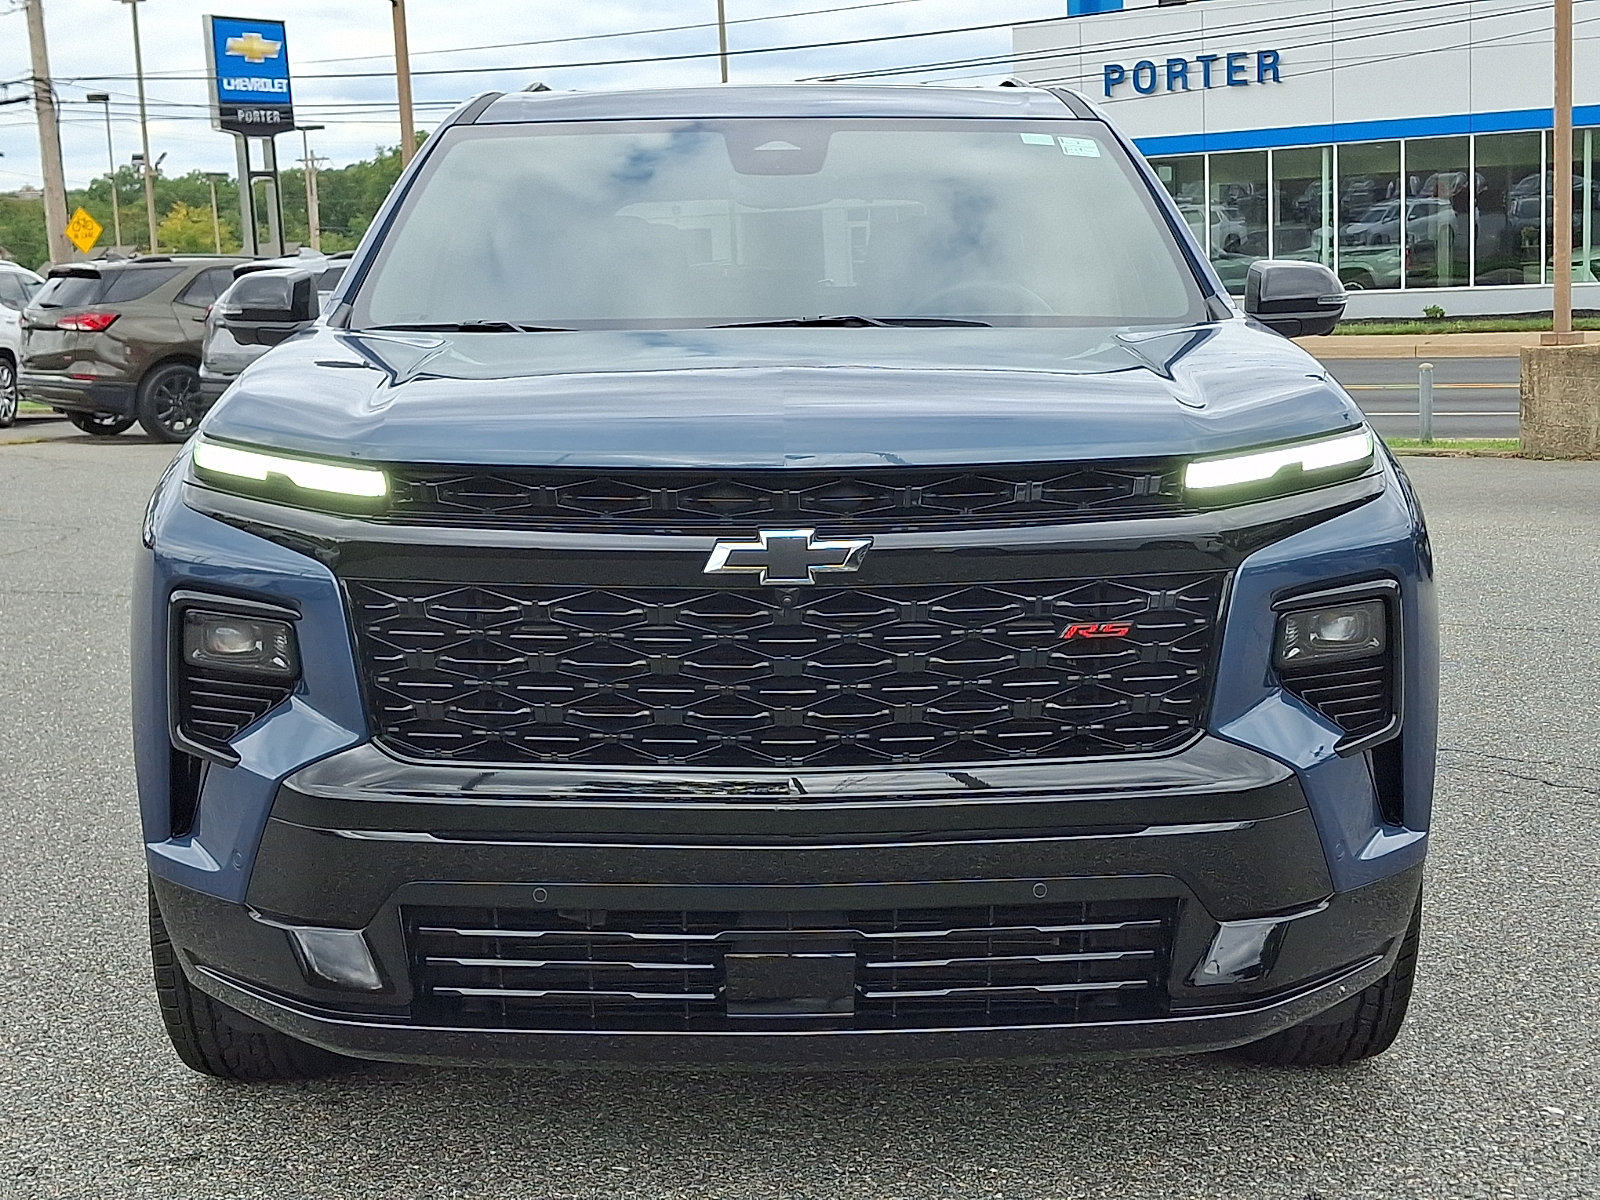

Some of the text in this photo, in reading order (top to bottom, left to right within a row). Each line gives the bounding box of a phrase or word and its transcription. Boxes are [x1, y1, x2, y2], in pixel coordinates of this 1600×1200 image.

[1104, 50, 1281, 97] PORTER
[223, 77, 288, 92] CHEVROLET
[237, 109, 280, 123] PORTER
[1059, 620, 1133, 639] RS
